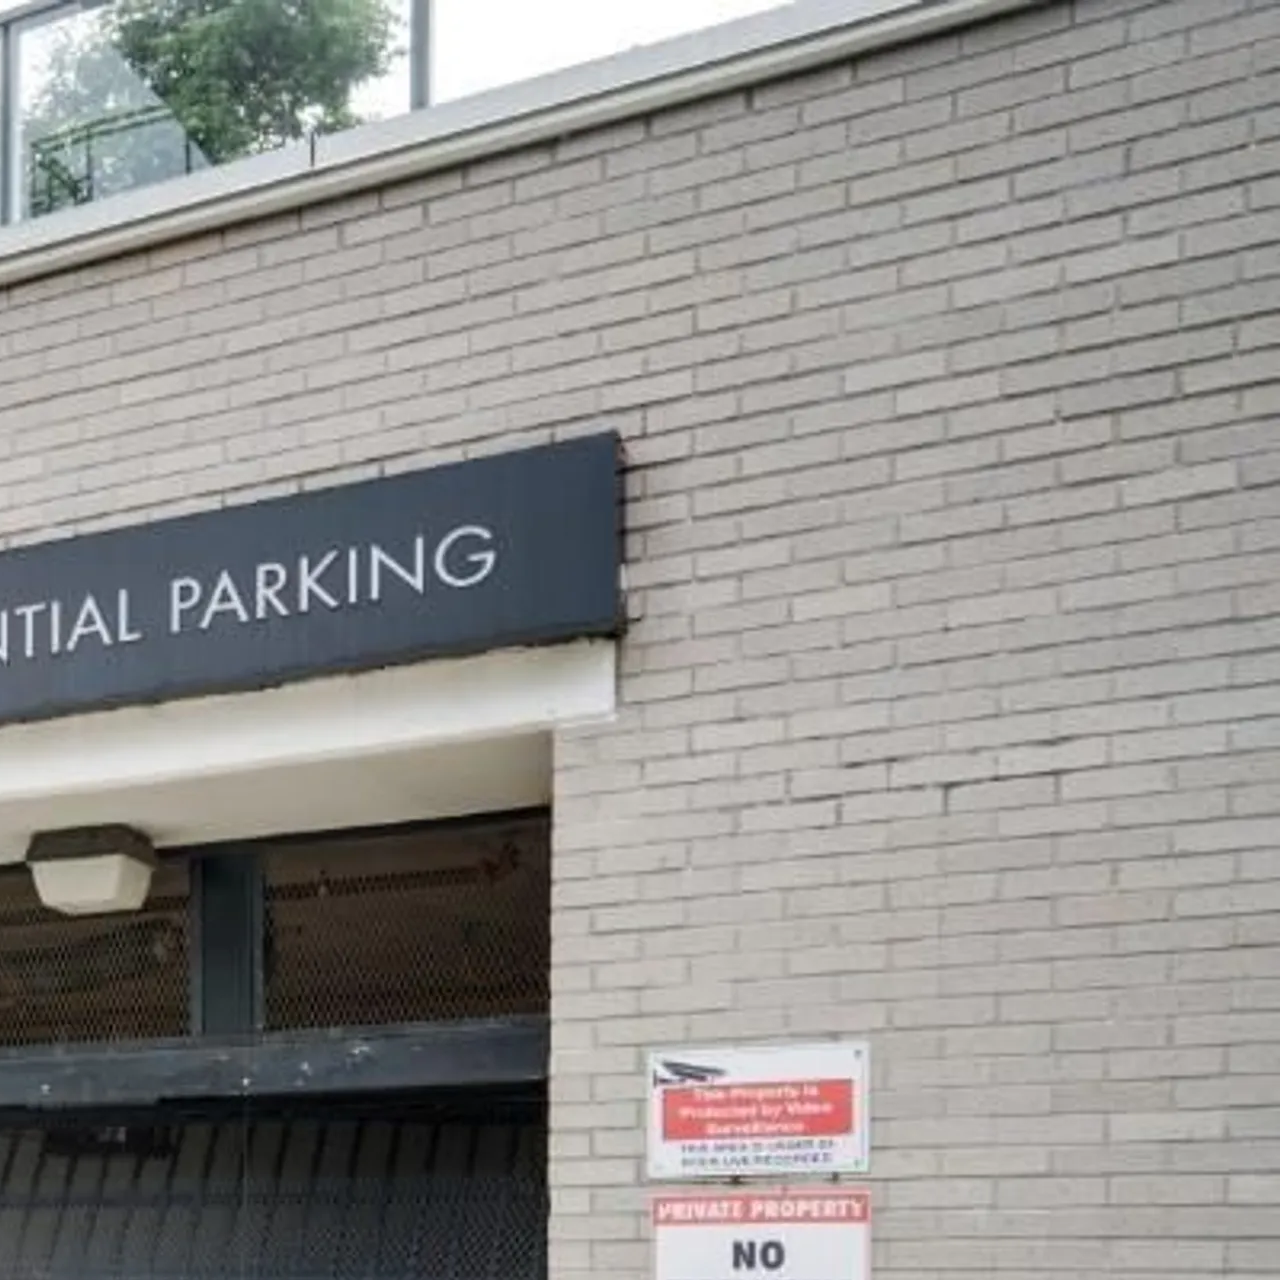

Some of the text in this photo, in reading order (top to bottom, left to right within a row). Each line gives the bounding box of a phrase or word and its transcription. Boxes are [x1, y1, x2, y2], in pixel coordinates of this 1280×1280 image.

[168, 524, 498, 637] PARKING
[658, 1199, 864, 1221] PRIVATE PROPERTY
[731, 1240, 786, 1271] NO
